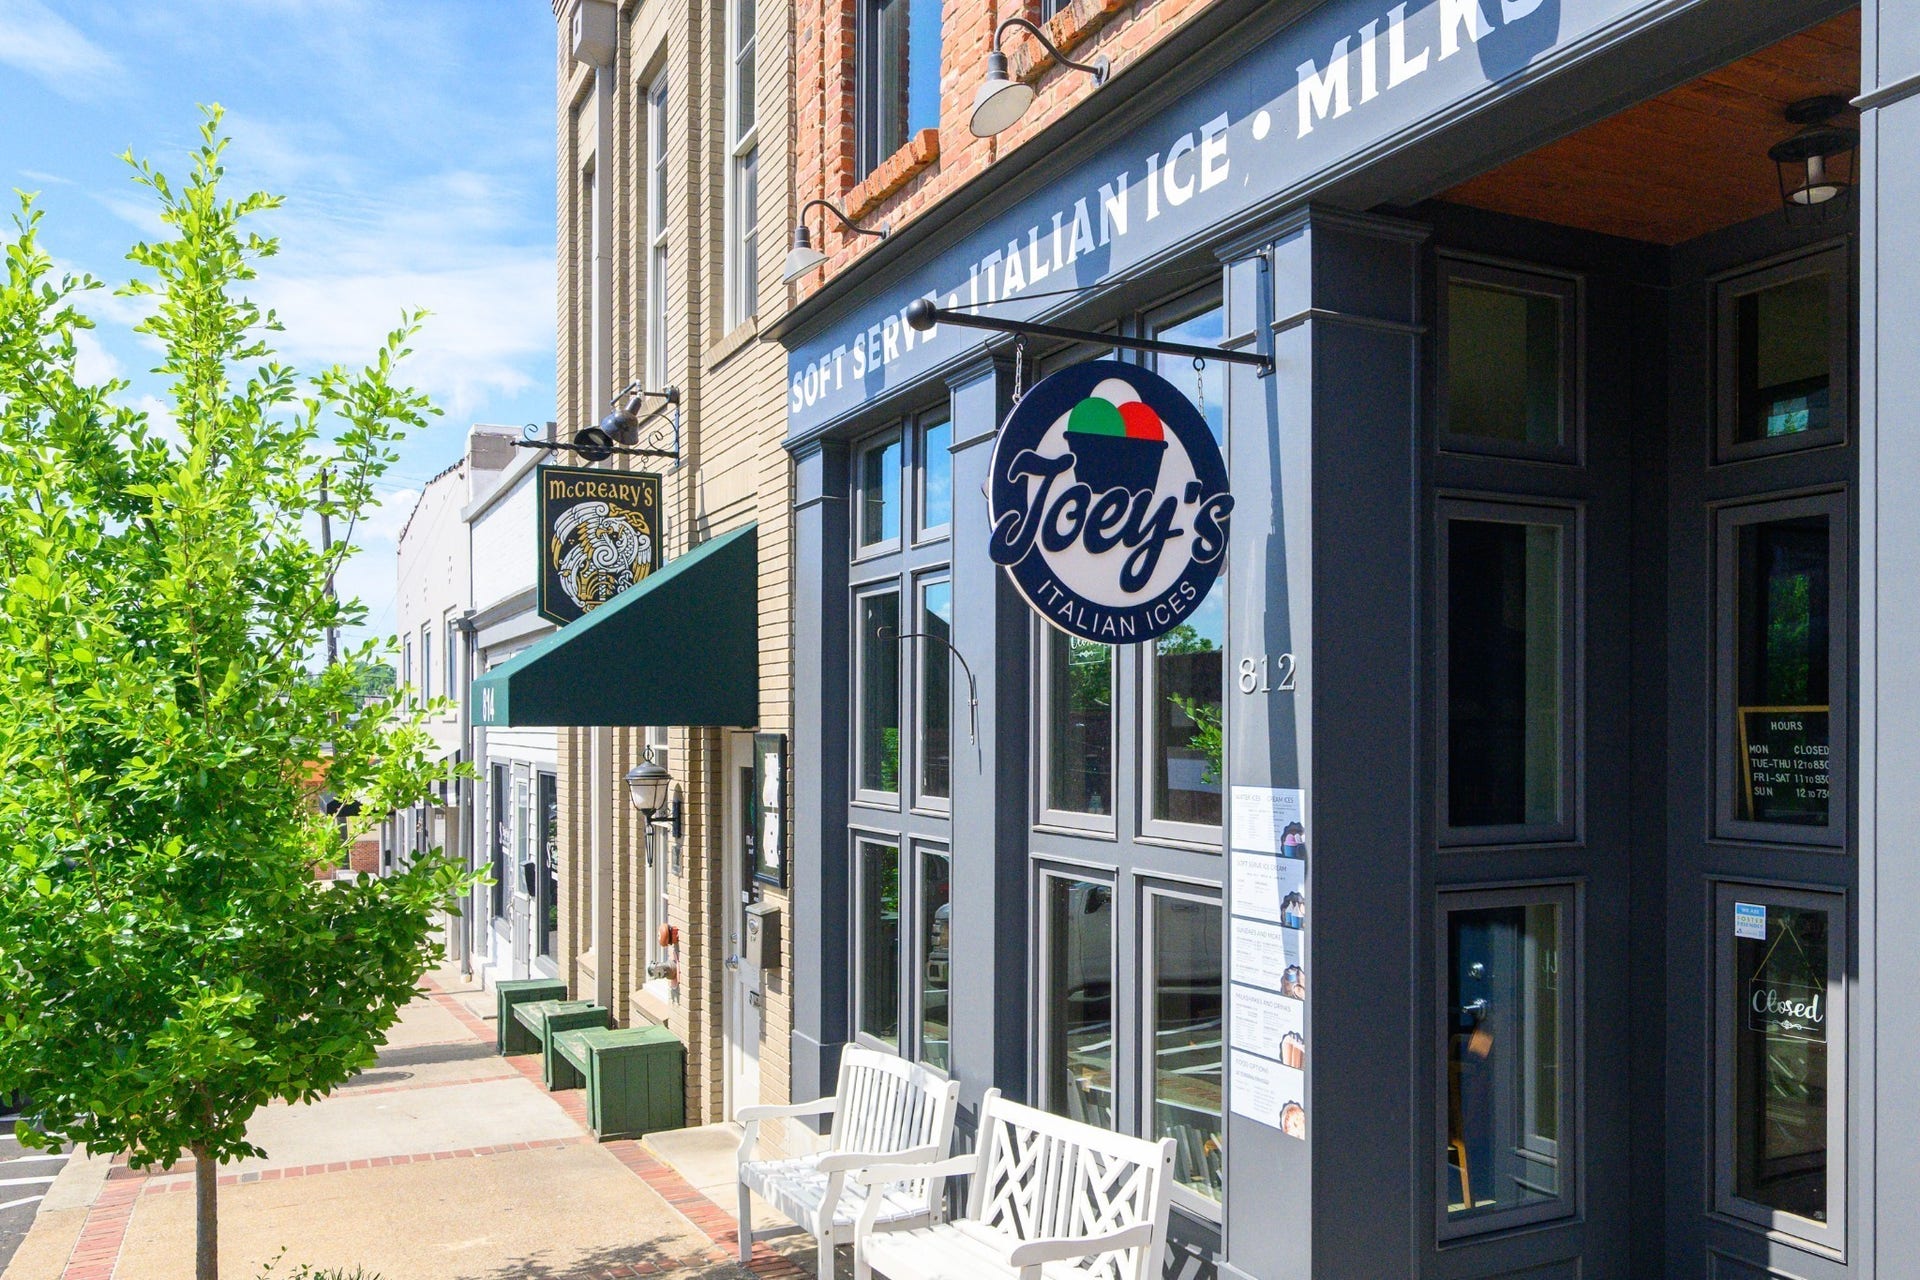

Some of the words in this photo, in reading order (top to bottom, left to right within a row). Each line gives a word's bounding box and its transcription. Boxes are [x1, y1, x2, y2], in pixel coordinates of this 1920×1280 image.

[792, 344, 847, 414] SOFT
[969, 172, 1129, 316] ITALIAN
[1146, 111, 1230, 222] ICE
[1296, 0, 1543, 139] MILK
[989, 449, 1235, 593] Joey's
[1037, 580, 1136, 637] ITALIAN
[1147, 580, 1197, 631] ICES
[1238, 653, 1297, 694] 812
[482, 687, 495, 722] 814
[1771, 721, 1803, 731] HOURS
[1749, 744, 1769, 754] MON
[1794, 745, 1829, 755] CLOSED
[1752, 759, 1790, 769] TUE-THU
[1753, 773, 1790, 783] FRI-SAT
[1754, 787, 1773, 796] SUN
[1752, 989, 1823, 1023] Closed
